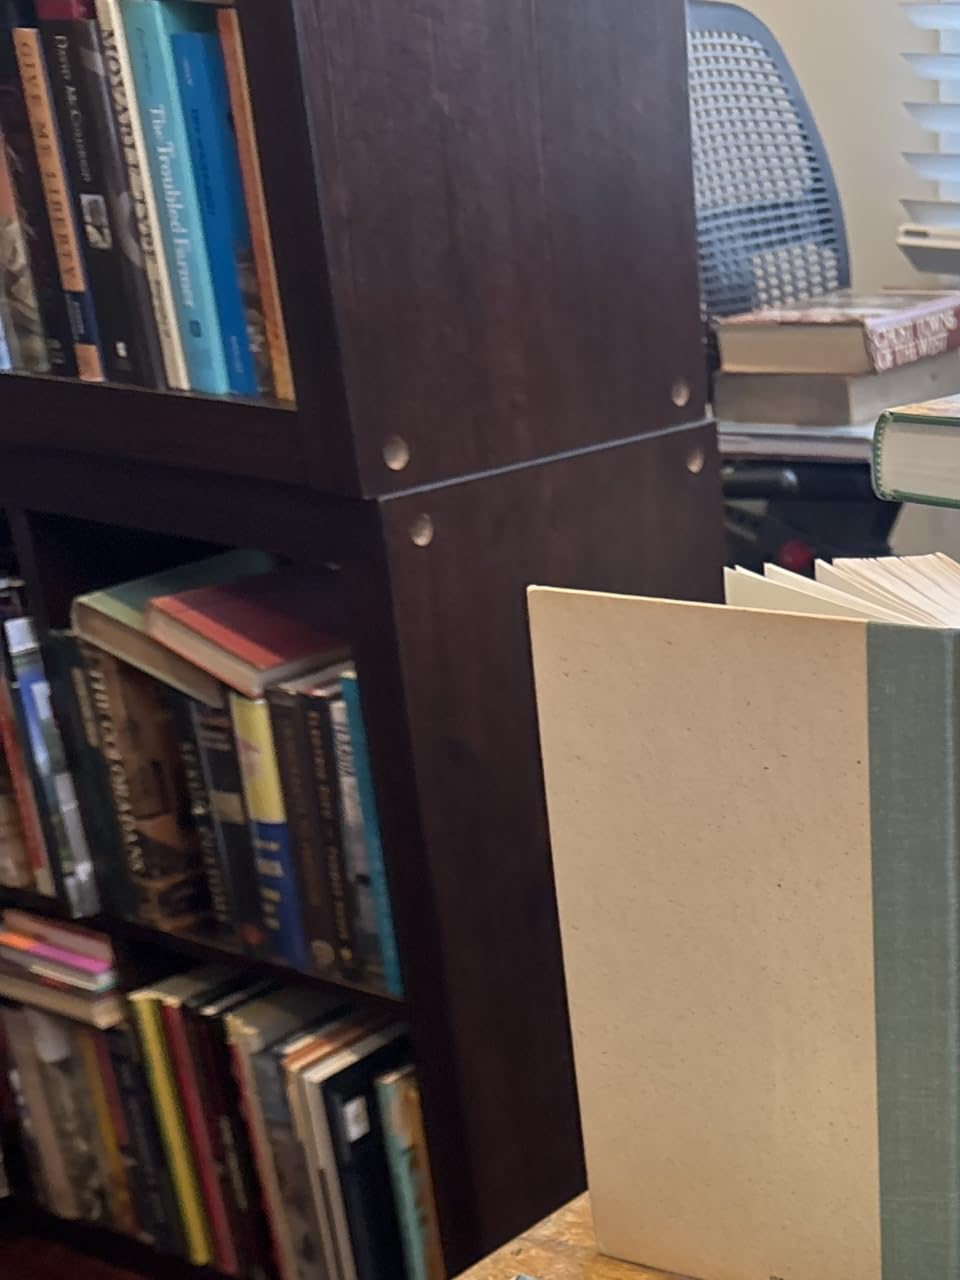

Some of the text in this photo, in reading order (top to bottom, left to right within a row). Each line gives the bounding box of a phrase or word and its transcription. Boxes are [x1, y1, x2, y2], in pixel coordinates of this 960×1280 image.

[150, 106, 195, 308] The Troubled Farmer
